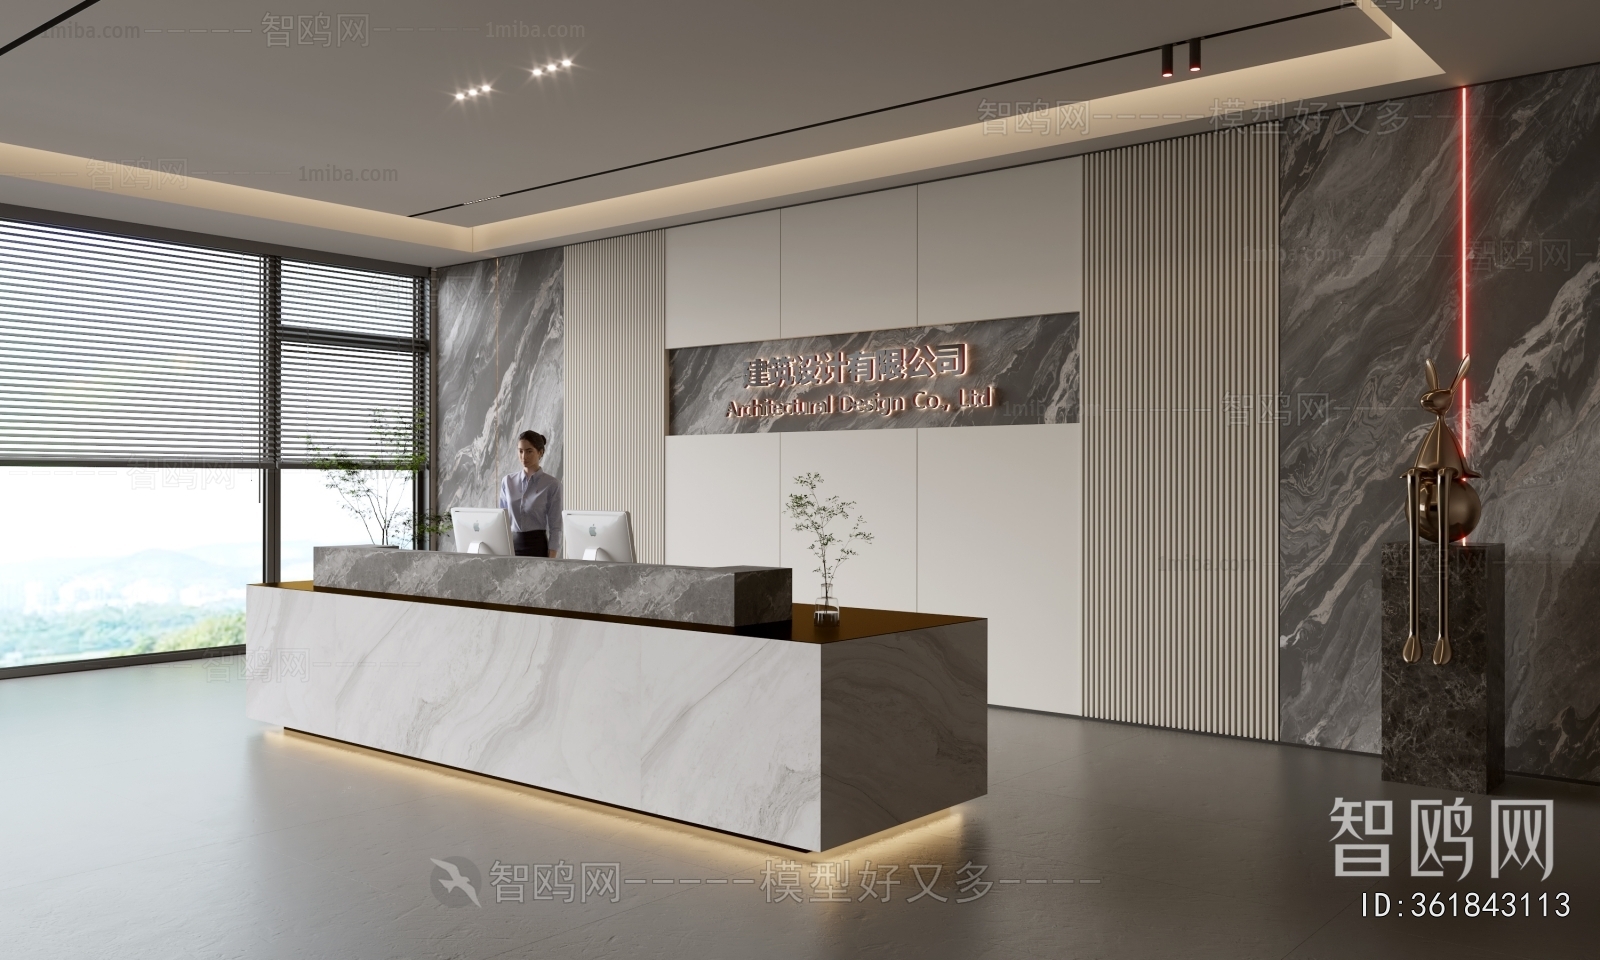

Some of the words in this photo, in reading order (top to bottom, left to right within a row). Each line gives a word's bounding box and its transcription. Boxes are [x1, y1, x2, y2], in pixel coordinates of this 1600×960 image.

[743, 343, 968, 389] 建筑设计有限公司
[725, 394, 836, 419] Architectural
[838, 392, 906, 418] Design
[912, 391, 951, 412] Co.,
[958, 386, 994, 408] Ltd
